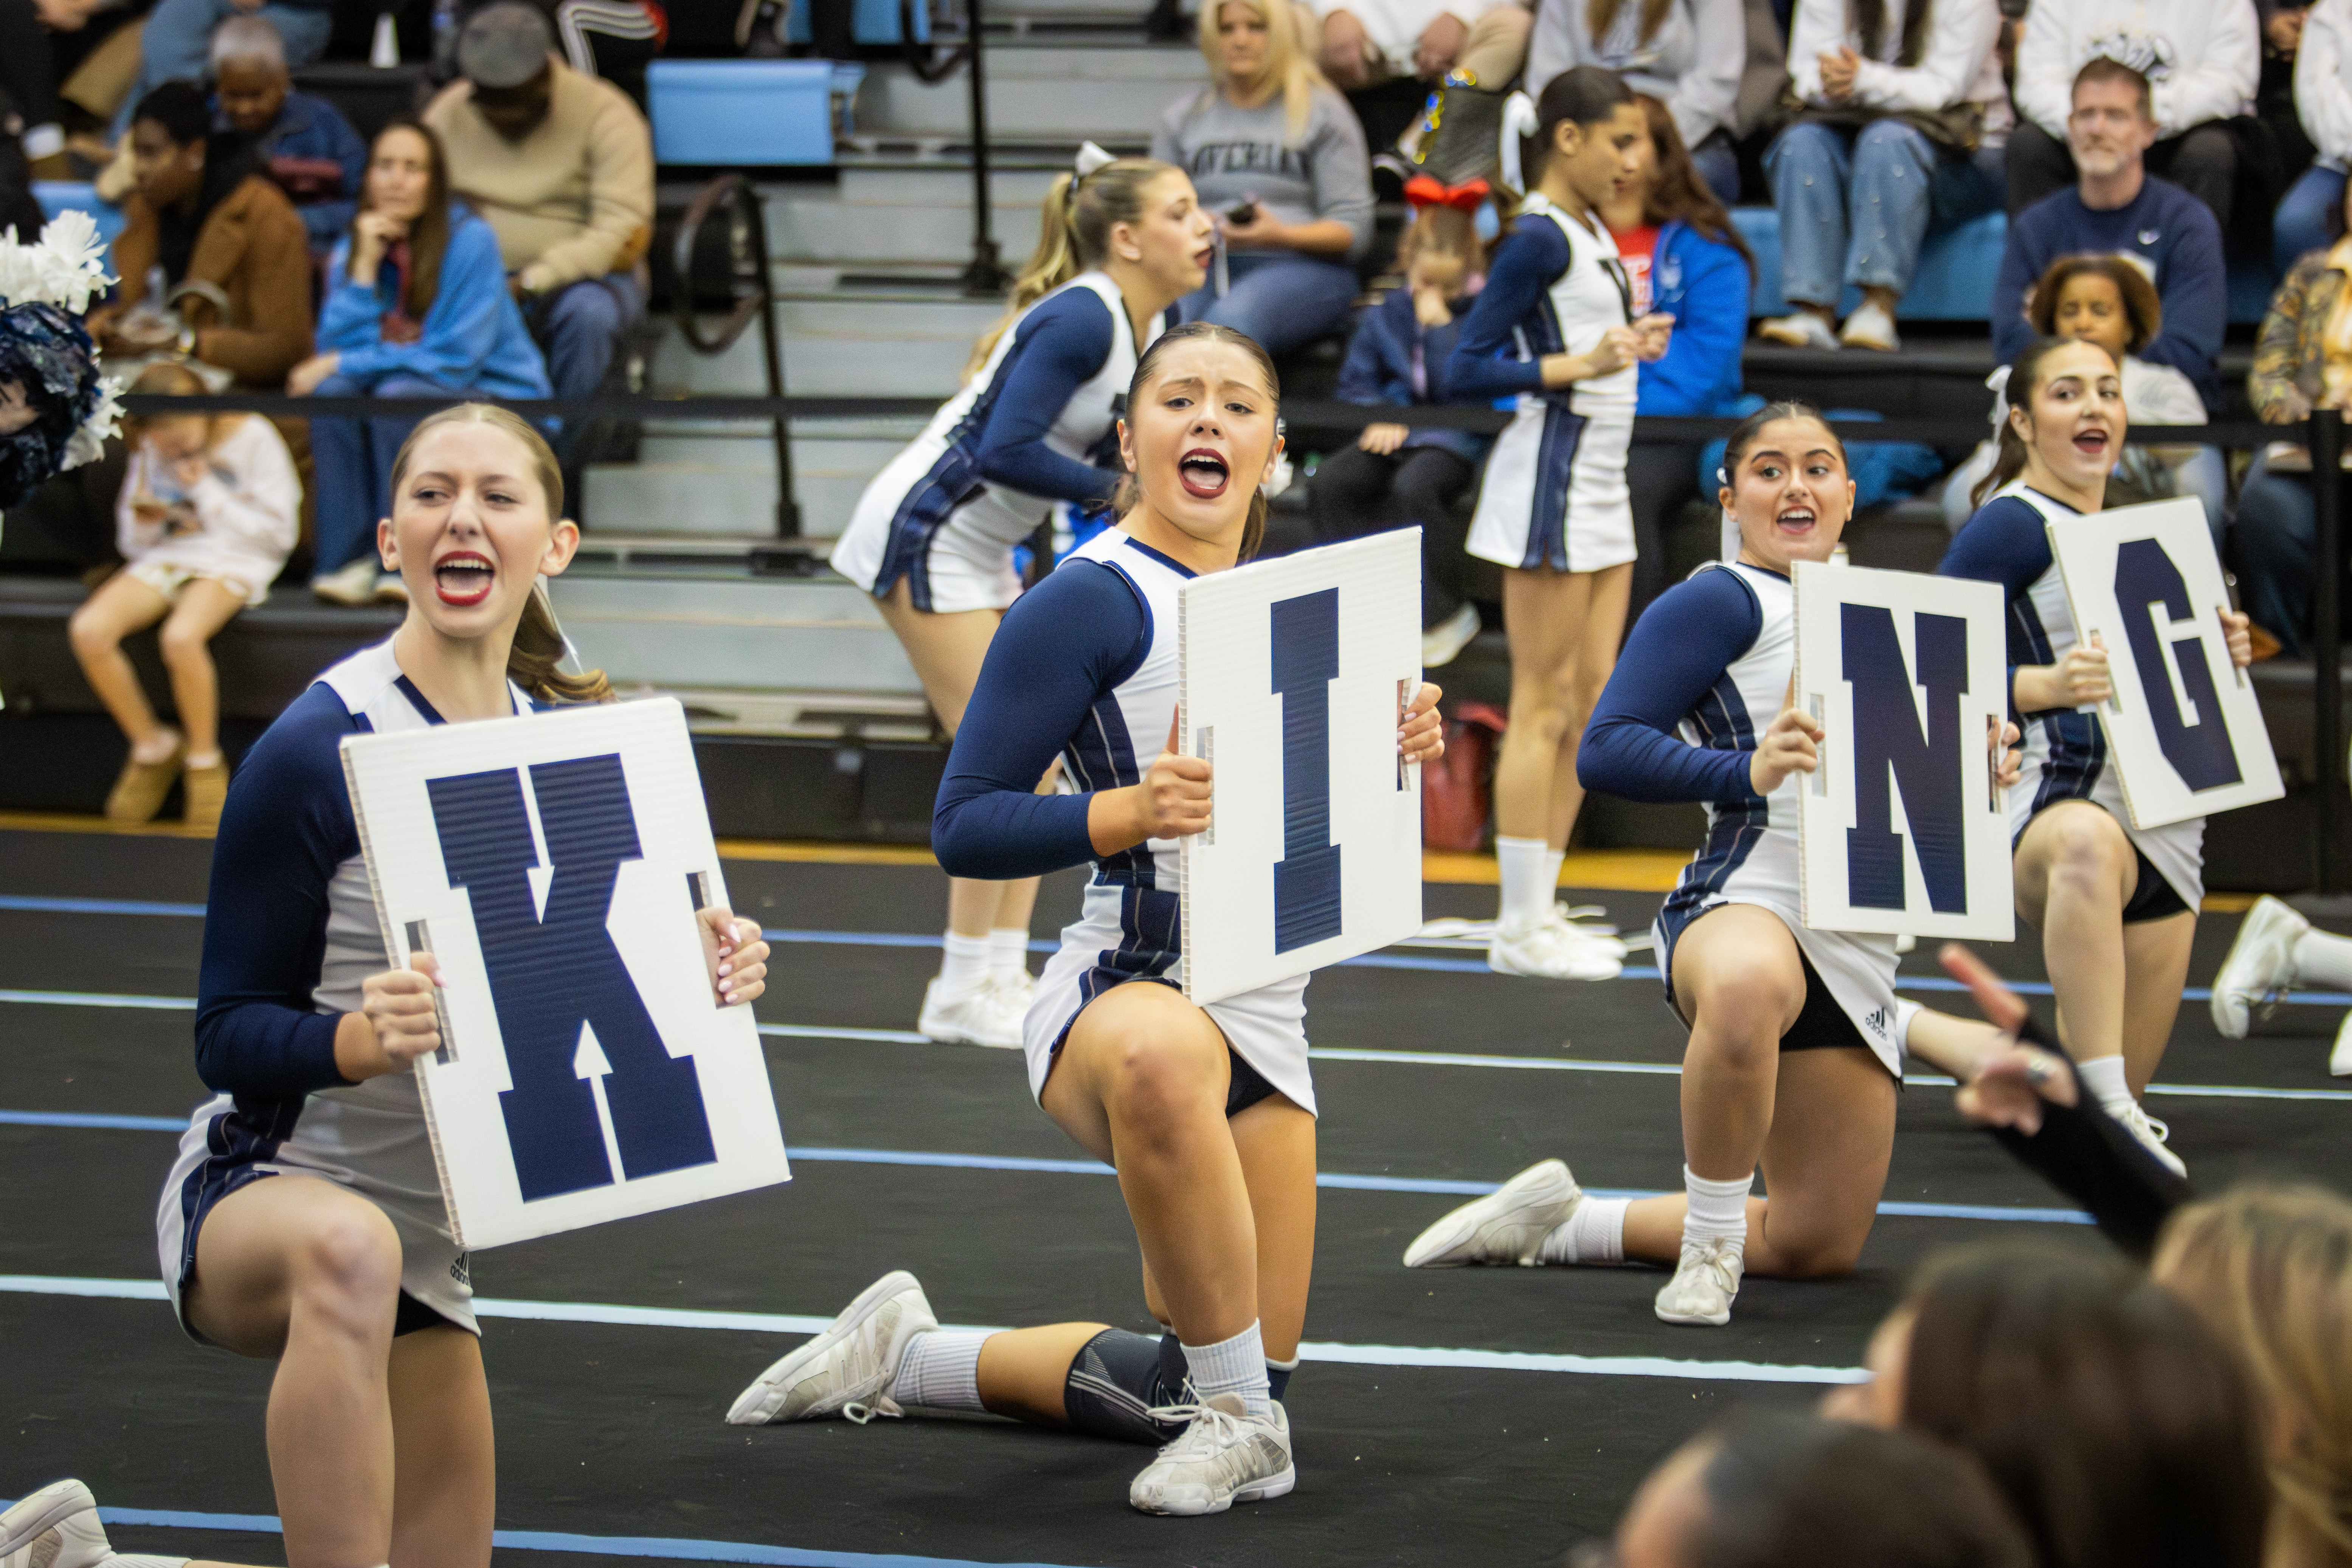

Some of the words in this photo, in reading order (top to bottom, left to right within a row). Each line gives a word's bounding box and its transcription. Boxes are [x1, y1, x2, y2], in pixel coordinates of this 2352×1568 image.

[1271, 587, 1342, 955] I
[1840, 602, 1969, 915] N
[2114, 538, 2243, 794] G
[426, 753, 717, 1204] K
